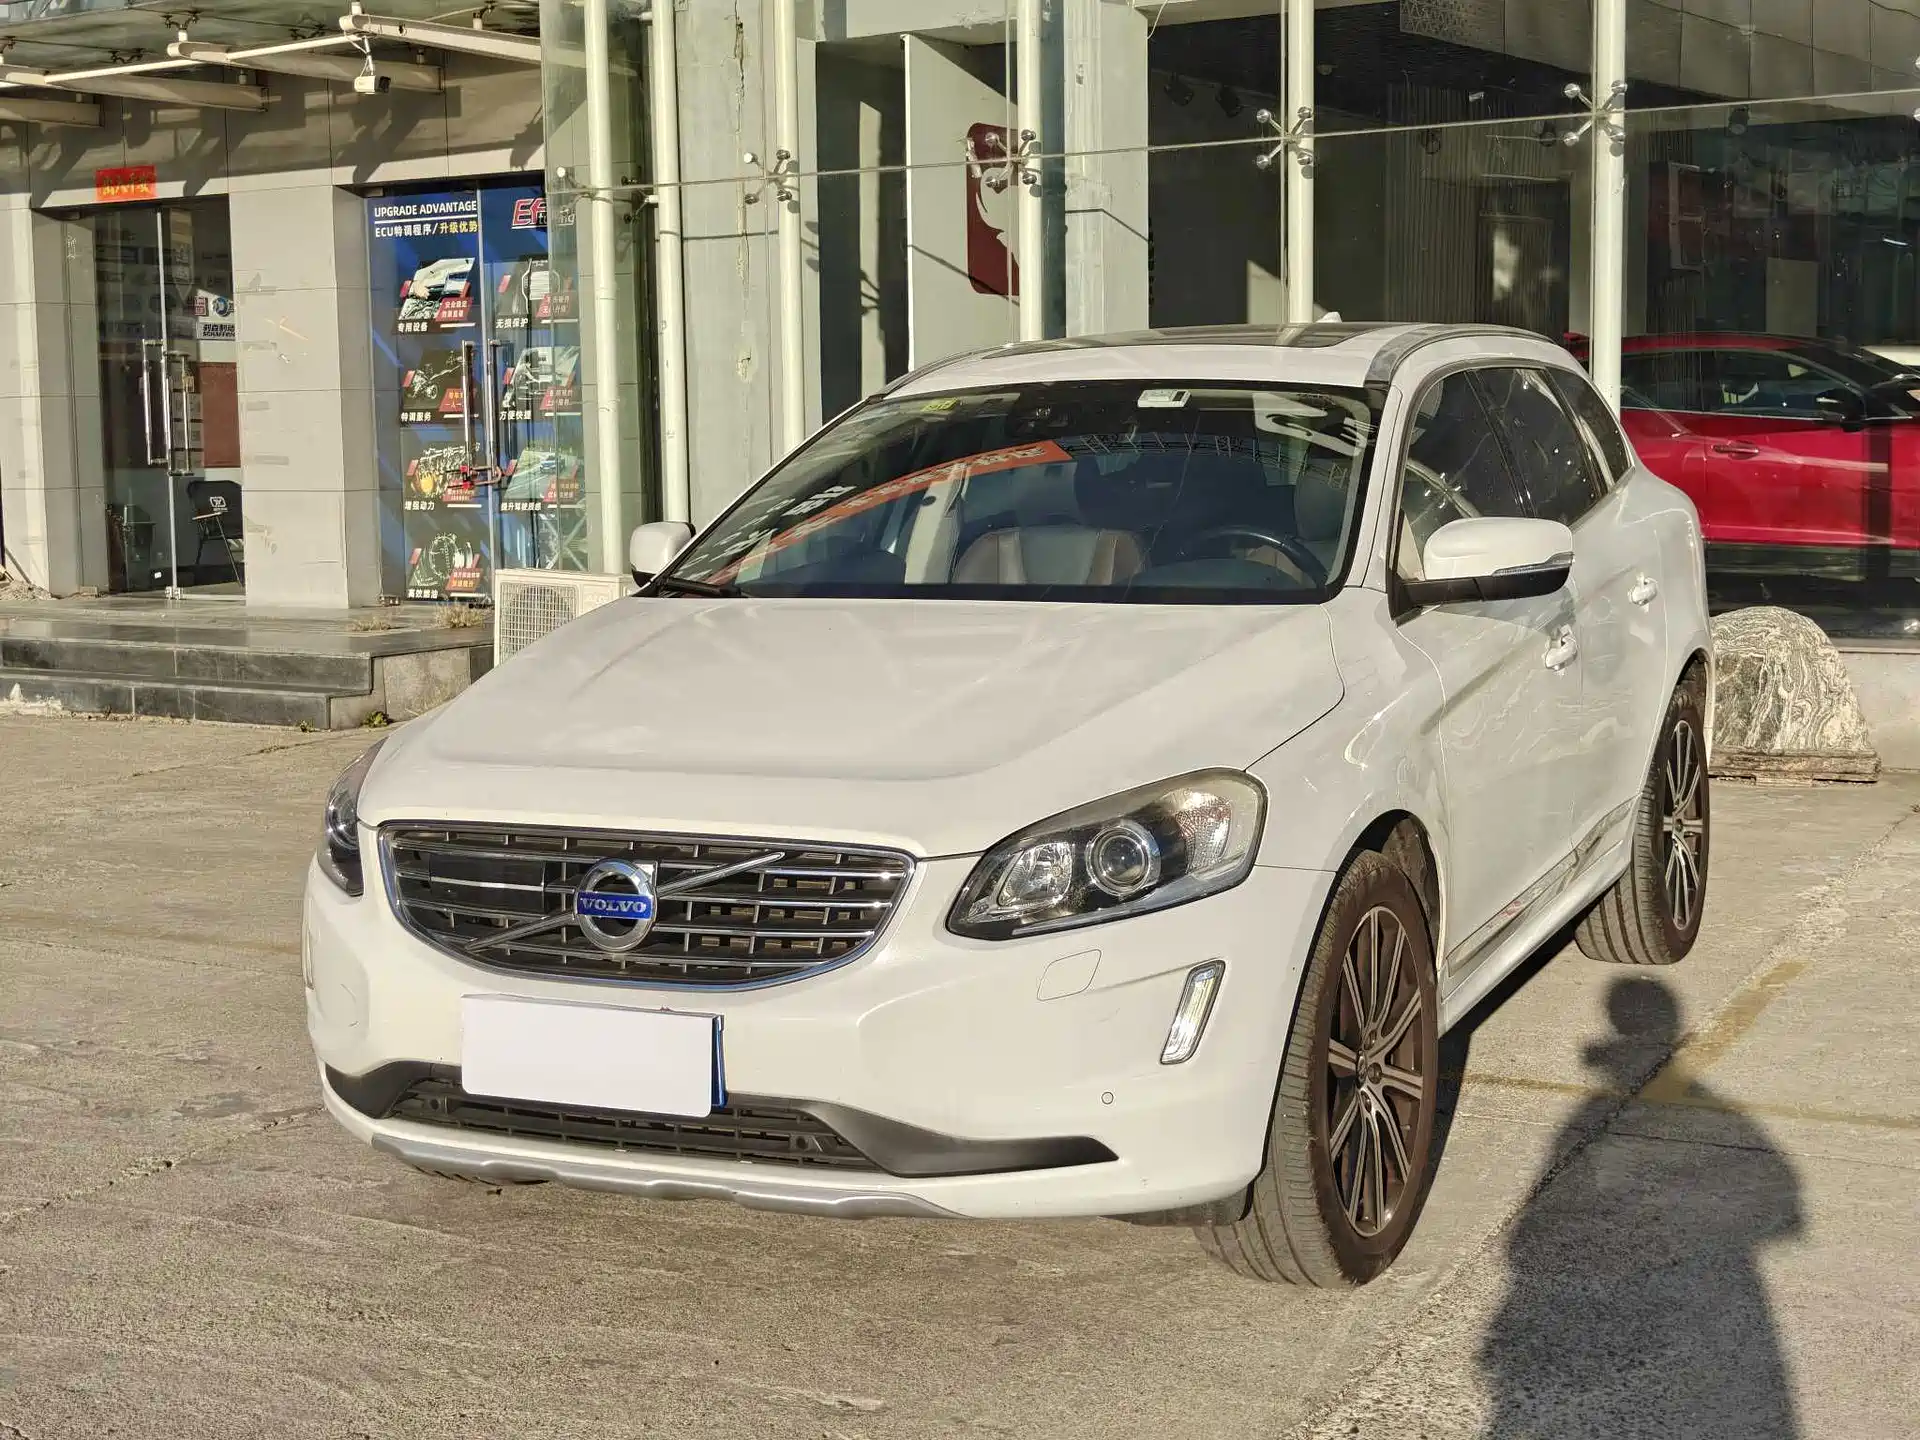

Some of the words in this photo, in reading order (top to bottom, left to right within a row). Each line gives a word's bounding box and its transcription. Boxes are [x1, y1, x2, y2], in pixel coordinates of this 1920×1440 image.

[374, 204, 417, 218] UPGRADE
[419, 200, 477, 215] ADVANTAGE
[398, 321, 428, 332] 专用设备
[496, 318, 529, 329] 无损保护
[401, 411, 431, 421] 特调服务
[404, 500, 435, 511] 增强动力
[580, 898, 647, 913] VOLVO
